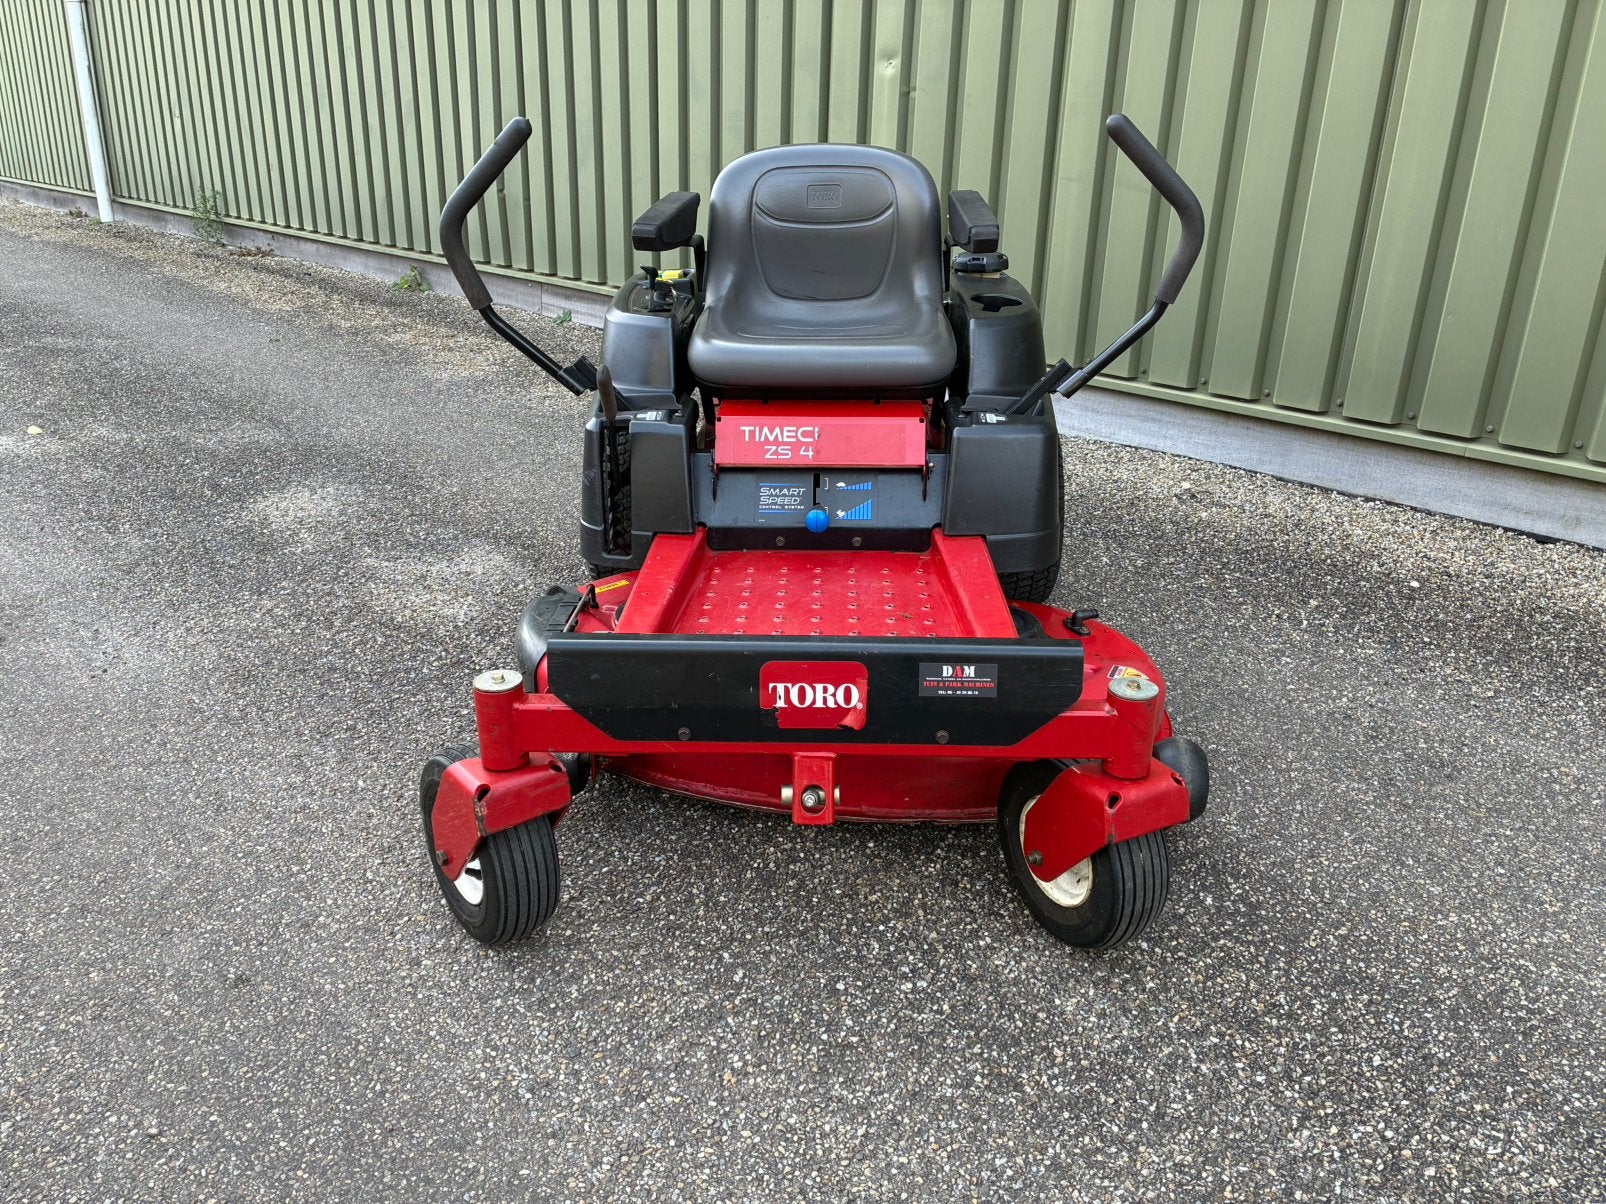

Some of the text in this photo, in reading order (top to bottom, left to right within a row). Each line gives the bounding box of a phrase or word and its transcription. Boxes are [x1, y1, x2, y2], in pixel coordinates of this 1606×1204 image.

[740, 426, 819, 442] TIMEC
[764, 446, 814, 459] ZS 4
[759, 487, 806, 496] SMART
[759, 496, 801, 505] SPEED
[942, 665, 976, 678] DAM
